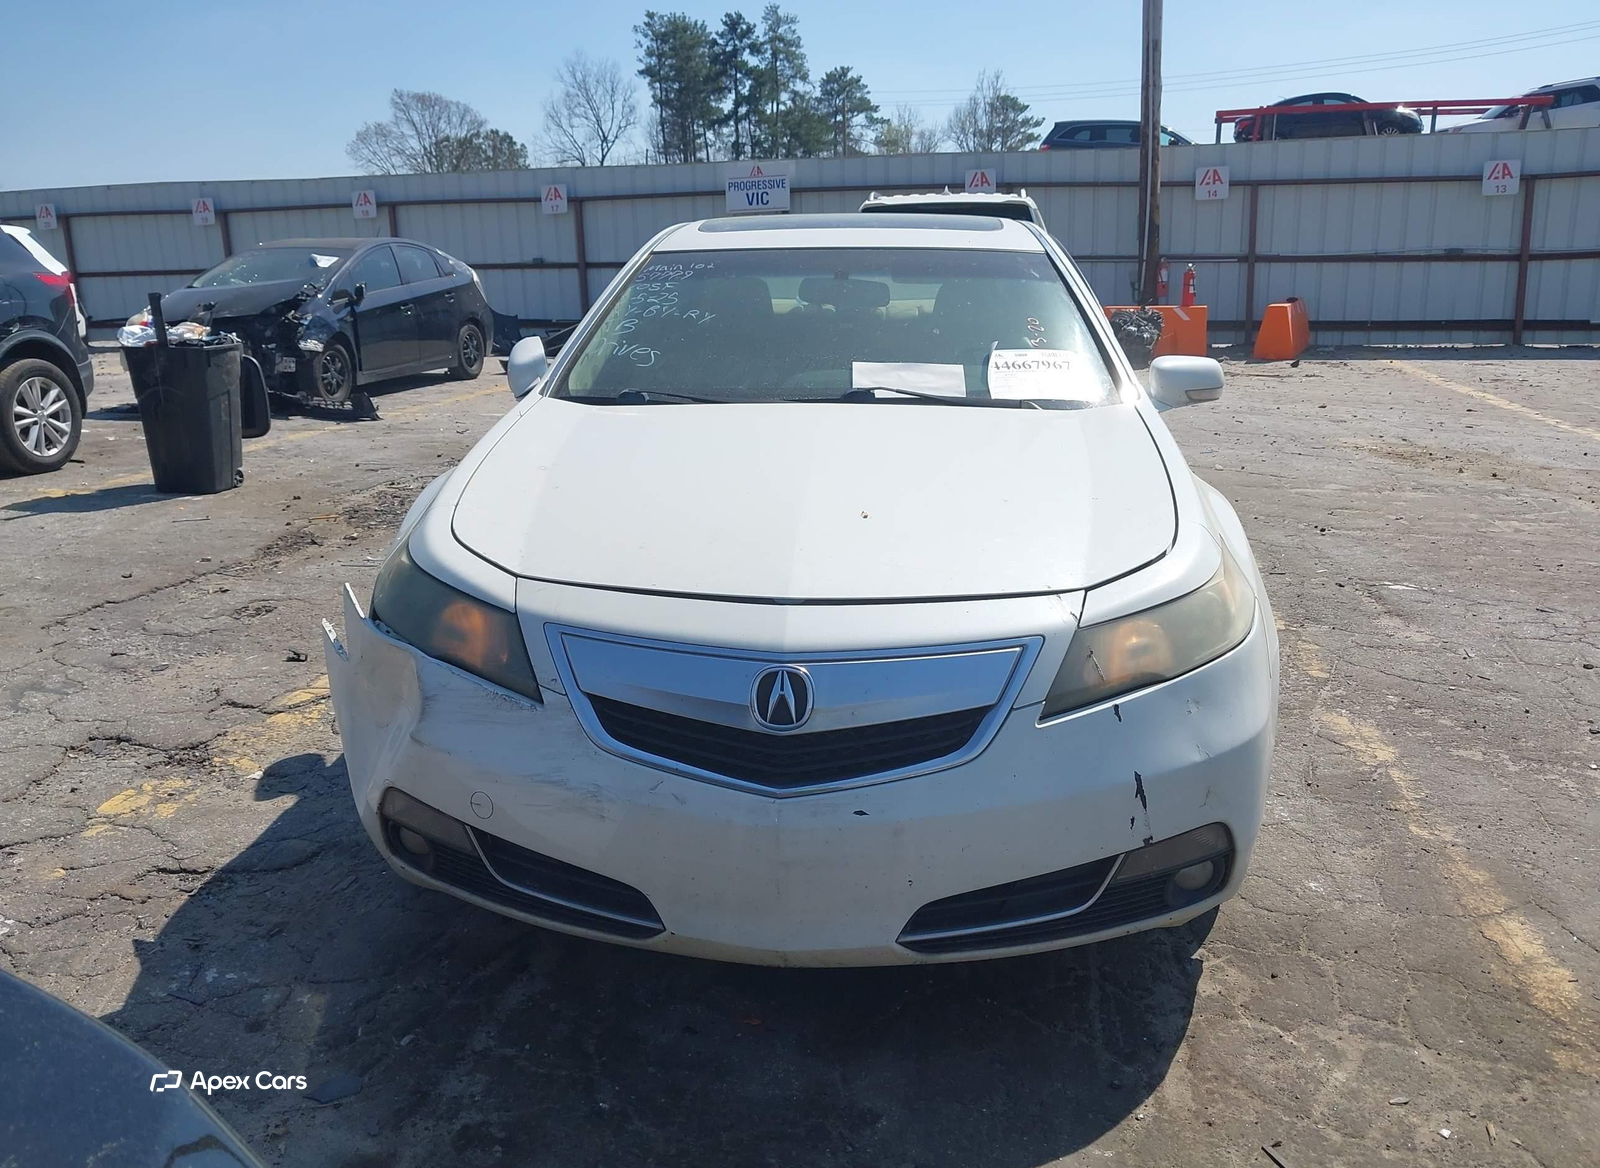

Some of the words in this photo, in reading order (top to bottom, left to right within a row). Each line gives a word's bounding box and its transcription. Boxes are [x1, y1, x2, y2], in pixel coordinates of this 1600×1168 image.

[728, 178, 786, 192] PROGRESSIVE
[1495, 184, 1507, 194] 13
[746, 191, 770, 206] VIC
[1207, 190, 1218, 199] 14
